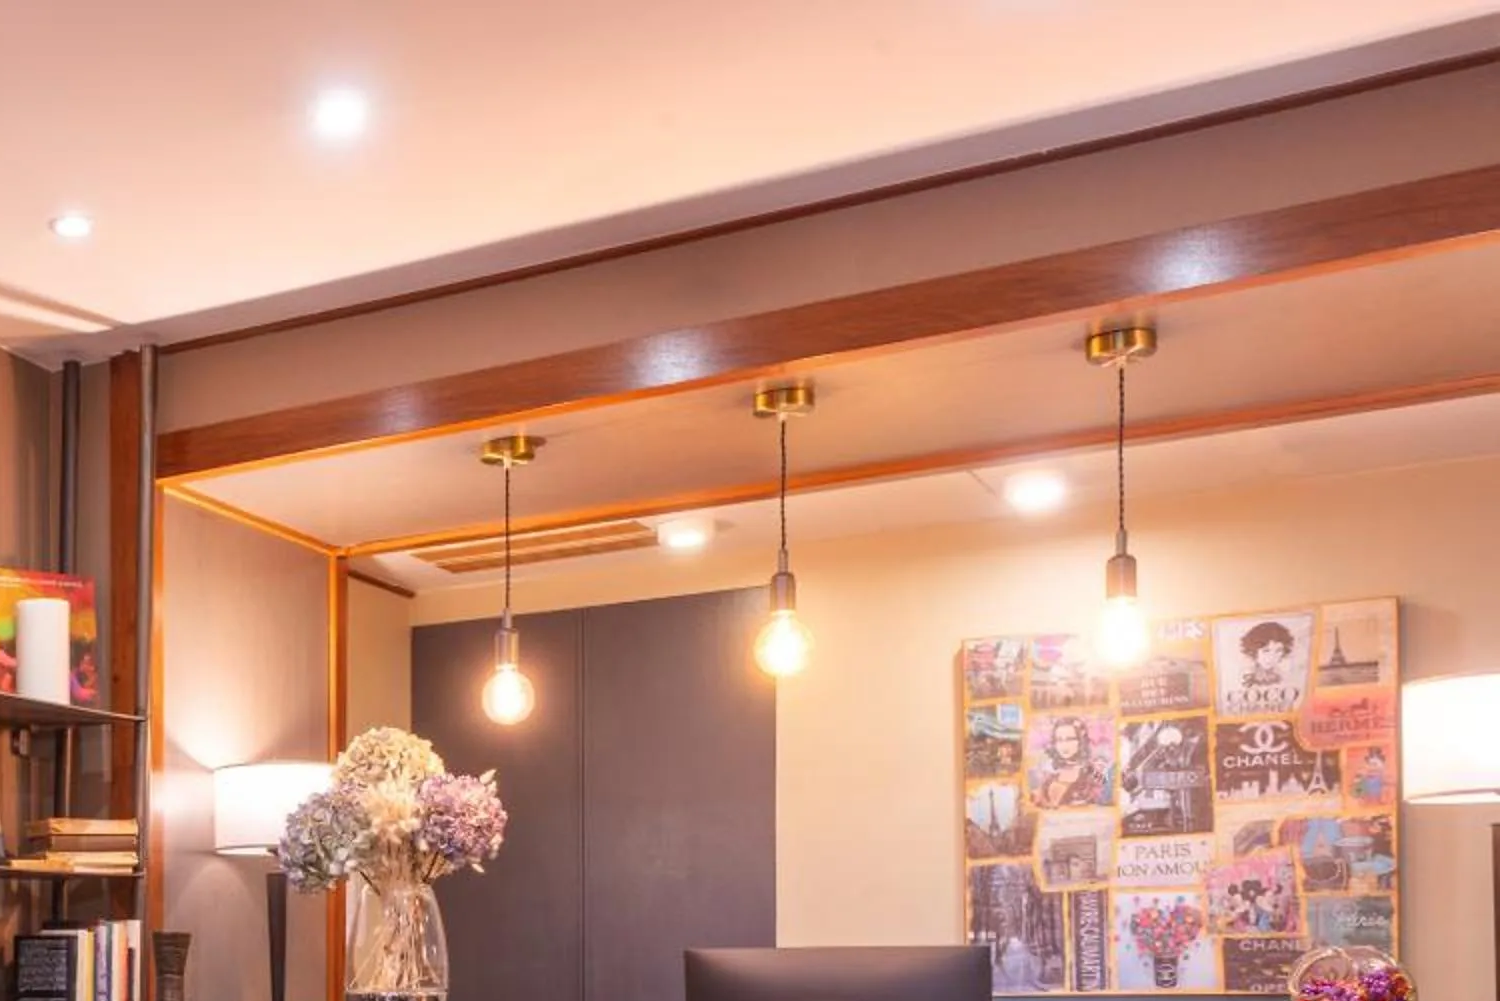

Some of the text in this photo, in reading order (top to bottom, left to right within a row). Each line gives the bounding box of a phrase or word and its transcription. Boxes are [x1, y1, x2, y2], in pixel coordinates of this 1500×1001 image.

[1227, 687, 1299, 702] COCO
[1223, 752, 1302, 769] CHANEL
[1134, 844, 1192, 861] PARIS
[1117, 864, 1149, 878] ON
[1237, 940, 1302, 952] CHAN
